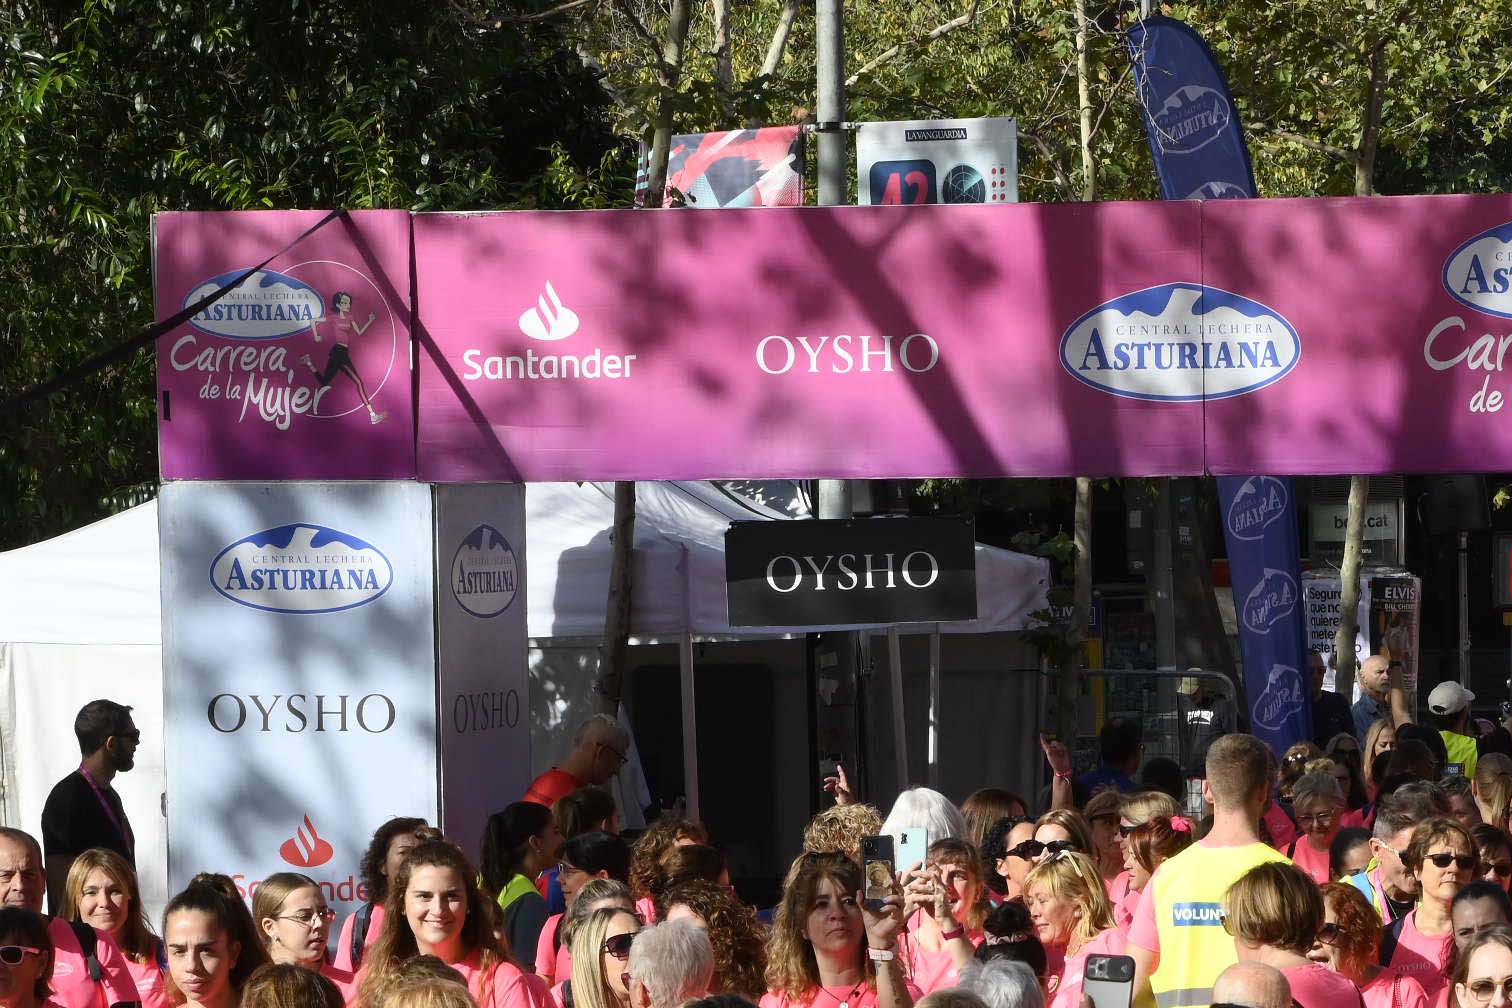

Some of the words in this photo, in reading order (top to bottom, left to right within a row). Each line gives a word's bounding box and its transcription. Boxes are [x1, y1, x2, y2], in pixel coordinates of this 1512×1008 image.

[1078, 326, 1282, 371] ASTURIANA
[1115, 323, 1191, 336] CENTRAL
[1199, 322, 1274, 335] LECHERA
[170, 335, 288, 372] Carrera
[463, 348, 637, 381] Santander
[756, 333, 939, 374] OYSHO
[199, 374, 221, 400] de
[225, 374, 242, 400] la
[238, 368, 332, 431] Mujer
[1469, 373, 1504, 414] de
[225, 557, 380, 591] ASTURIANA
[252, 554, 309, 564] CENTRAL
[316, 554, 373, 565] LECHERA
[456, 559, 515, 595] ASTURIANA
[765, 550, 939, 593] OYSHO
[1384, 586, 1415, 599] ELVIS
[207, 692, 396, 733] OYSHO
[453, 688, 520, 734] OYSHO
